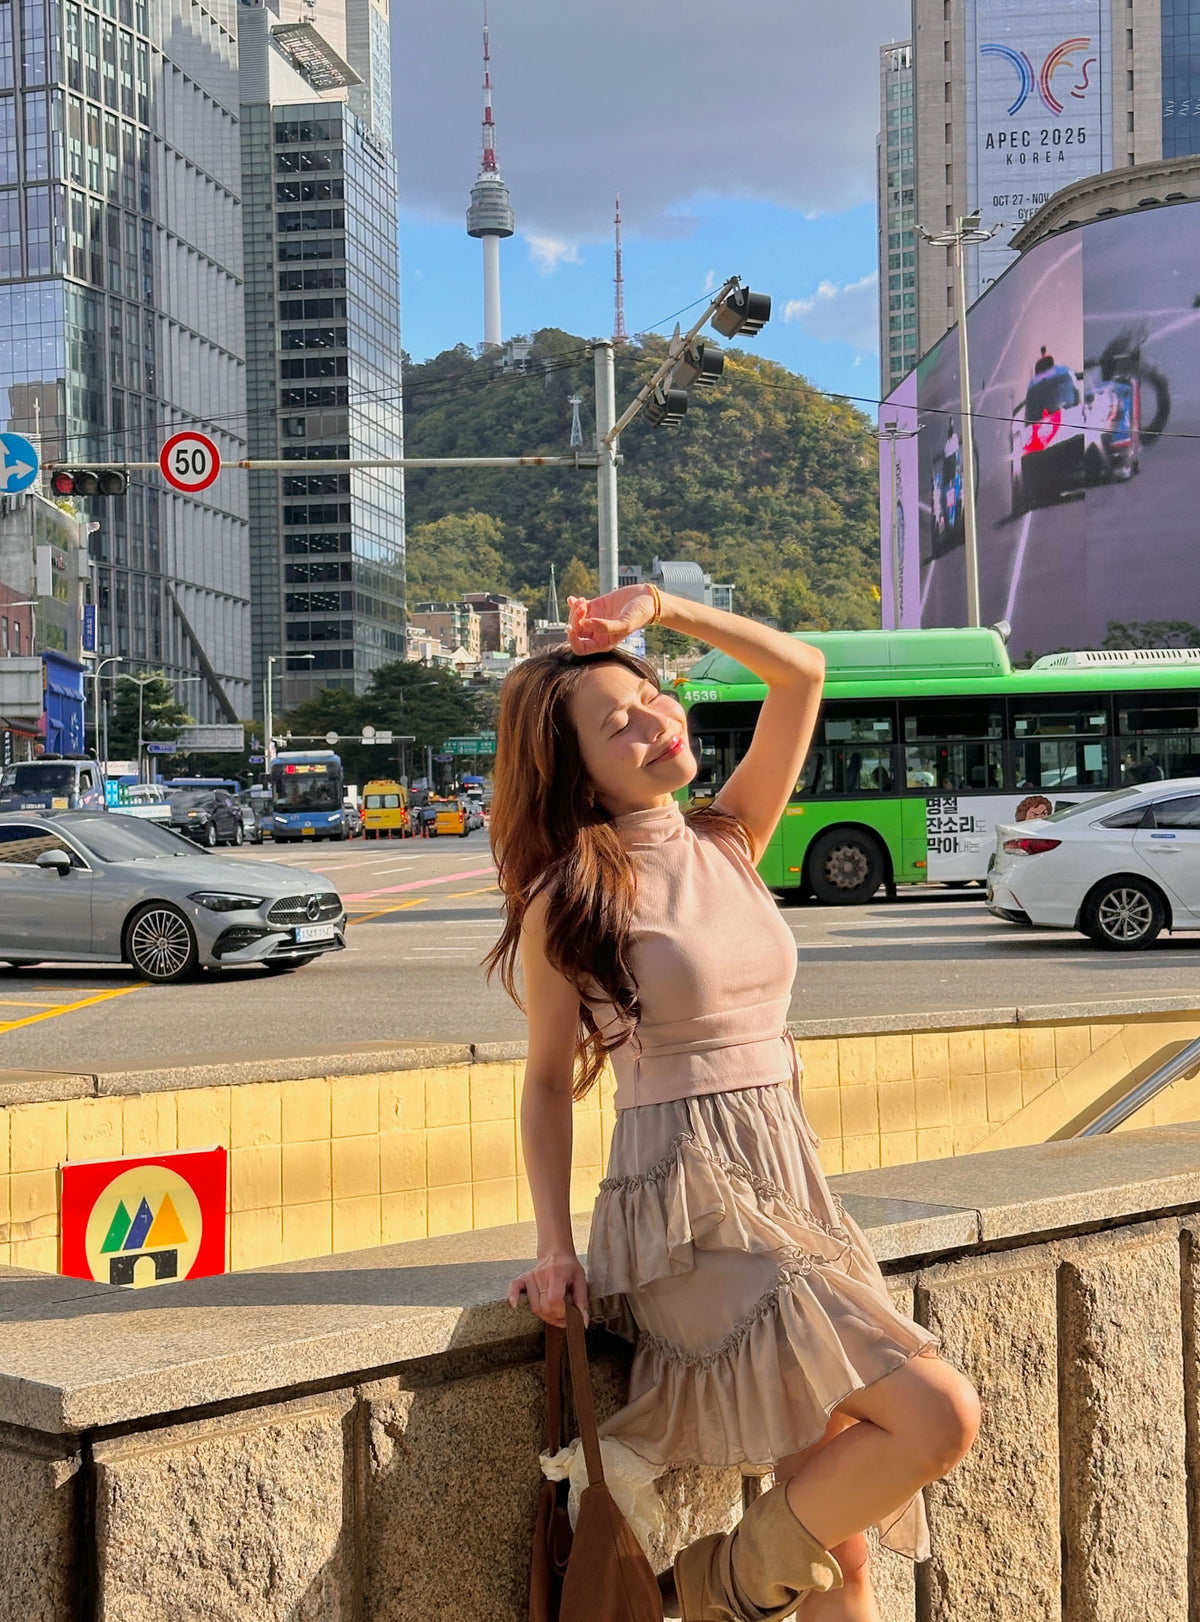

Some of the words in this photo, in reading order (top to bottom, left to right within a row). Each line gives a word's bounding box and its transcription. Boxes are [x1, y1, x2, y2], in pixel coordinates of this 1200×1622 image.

[985, 130, 1030, 150] APEC
[1040, 127, 1086, 146] 2025
[1006, 150, 1065, 166] KOREA
[993, 195, 1009, 207] OCT
[1012, 194, 1023, 206] 27
[1032, 193, 1049, 204] NOV
[175, 448, 206, 476] 50
[684, 690, 717, 702] 4536
[926, 797, 958, 815] 명절
[926, 816, 987, 834] 잔소리도
[927, 837, 980, 854] 막아내는
